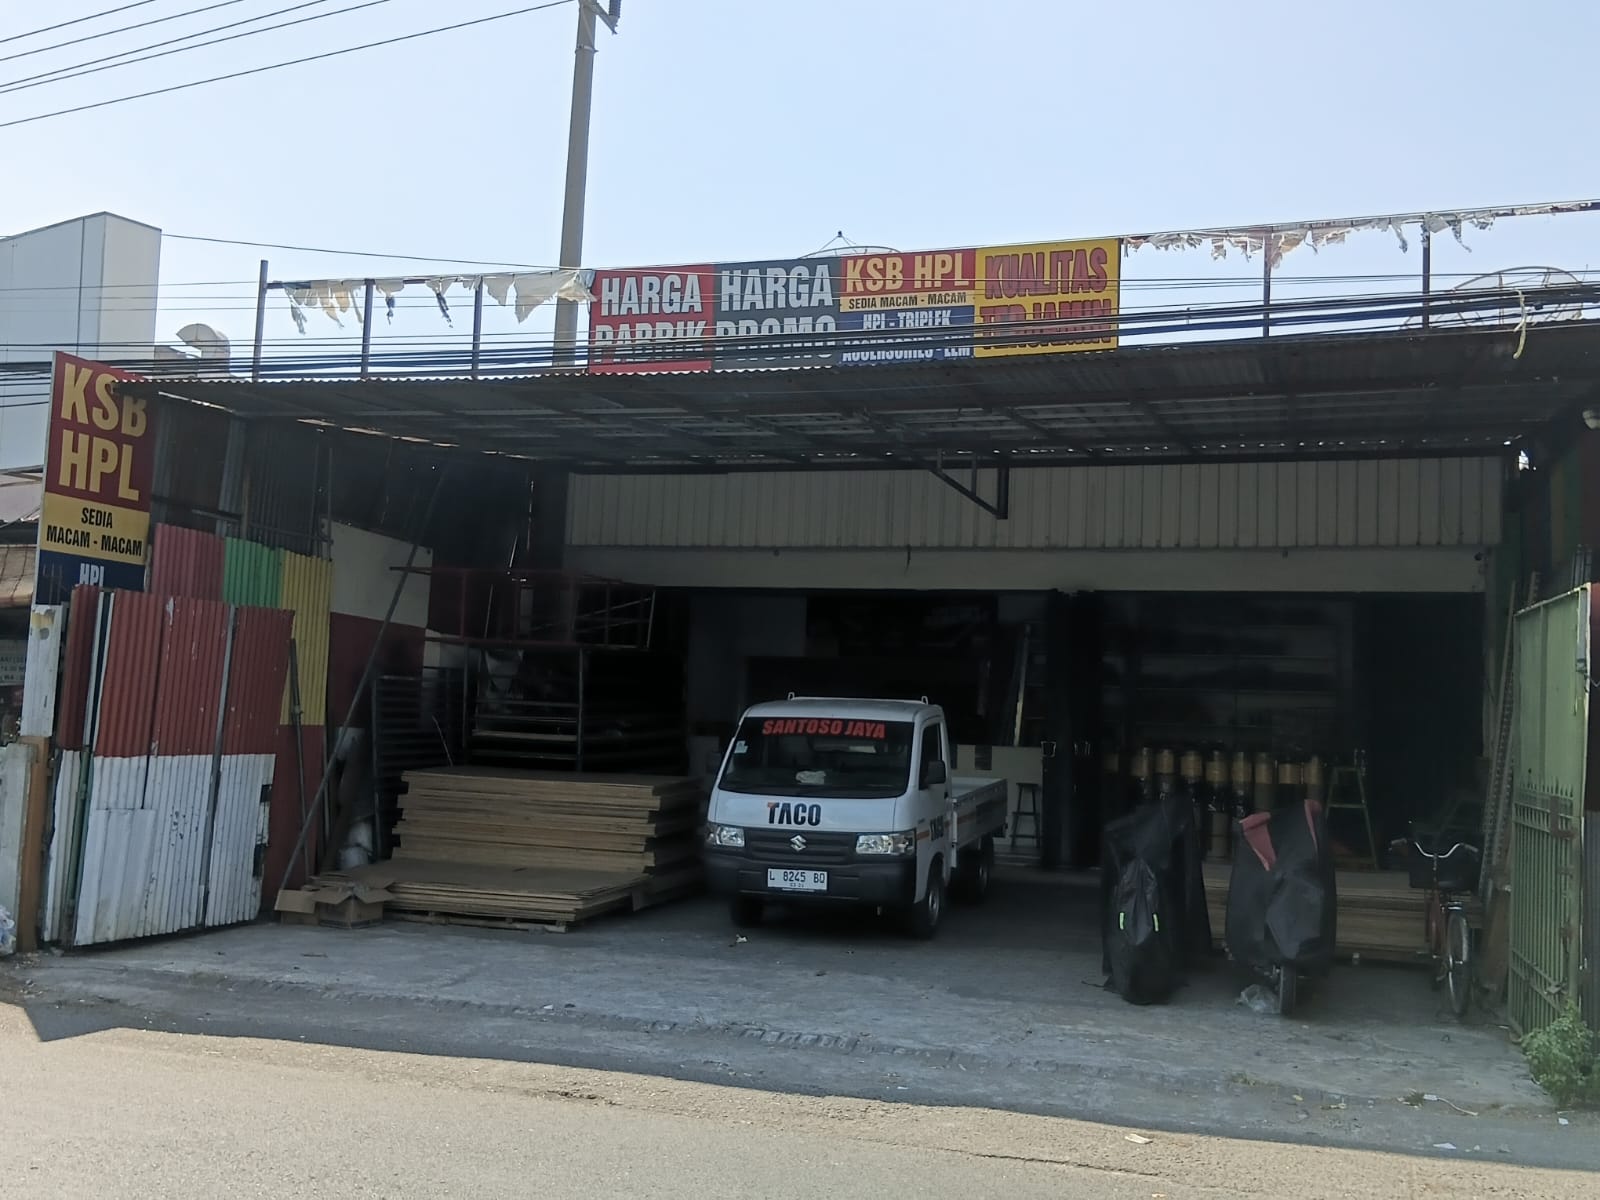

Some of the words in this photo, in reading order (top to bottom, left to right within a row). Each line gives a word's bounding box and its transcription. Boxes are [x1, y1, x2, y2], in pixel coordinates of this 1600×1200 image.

[720, 264, 834, 312] HARGA
[846, 256, 904, 293] KSB
[913, 252, 970, 289] HPL
[984, 247, 1108, 300] KUALITAS
[601, 274, 703, 316] HARGA
[848, 297, 878, 310] SEDIA
[880, 294, 918, 308] MACAM
[927, 291, 967, 306] MACAM
[61, 362, 148, 438] KSB
[58, 428, 140, 502] HPL
[81, 507, 113, 529] SEDIA
[46, 525, 91, 549] MACAM
[100, 533, 143, 557] MACAM
[762, 719, 843, 736] SANTOSO
[844, 722, 886, 739] JAYA
[767, 802, 822, 826] TACO
[769, 870, 775, 881] L
[783, 870, 806, 883] 8245
